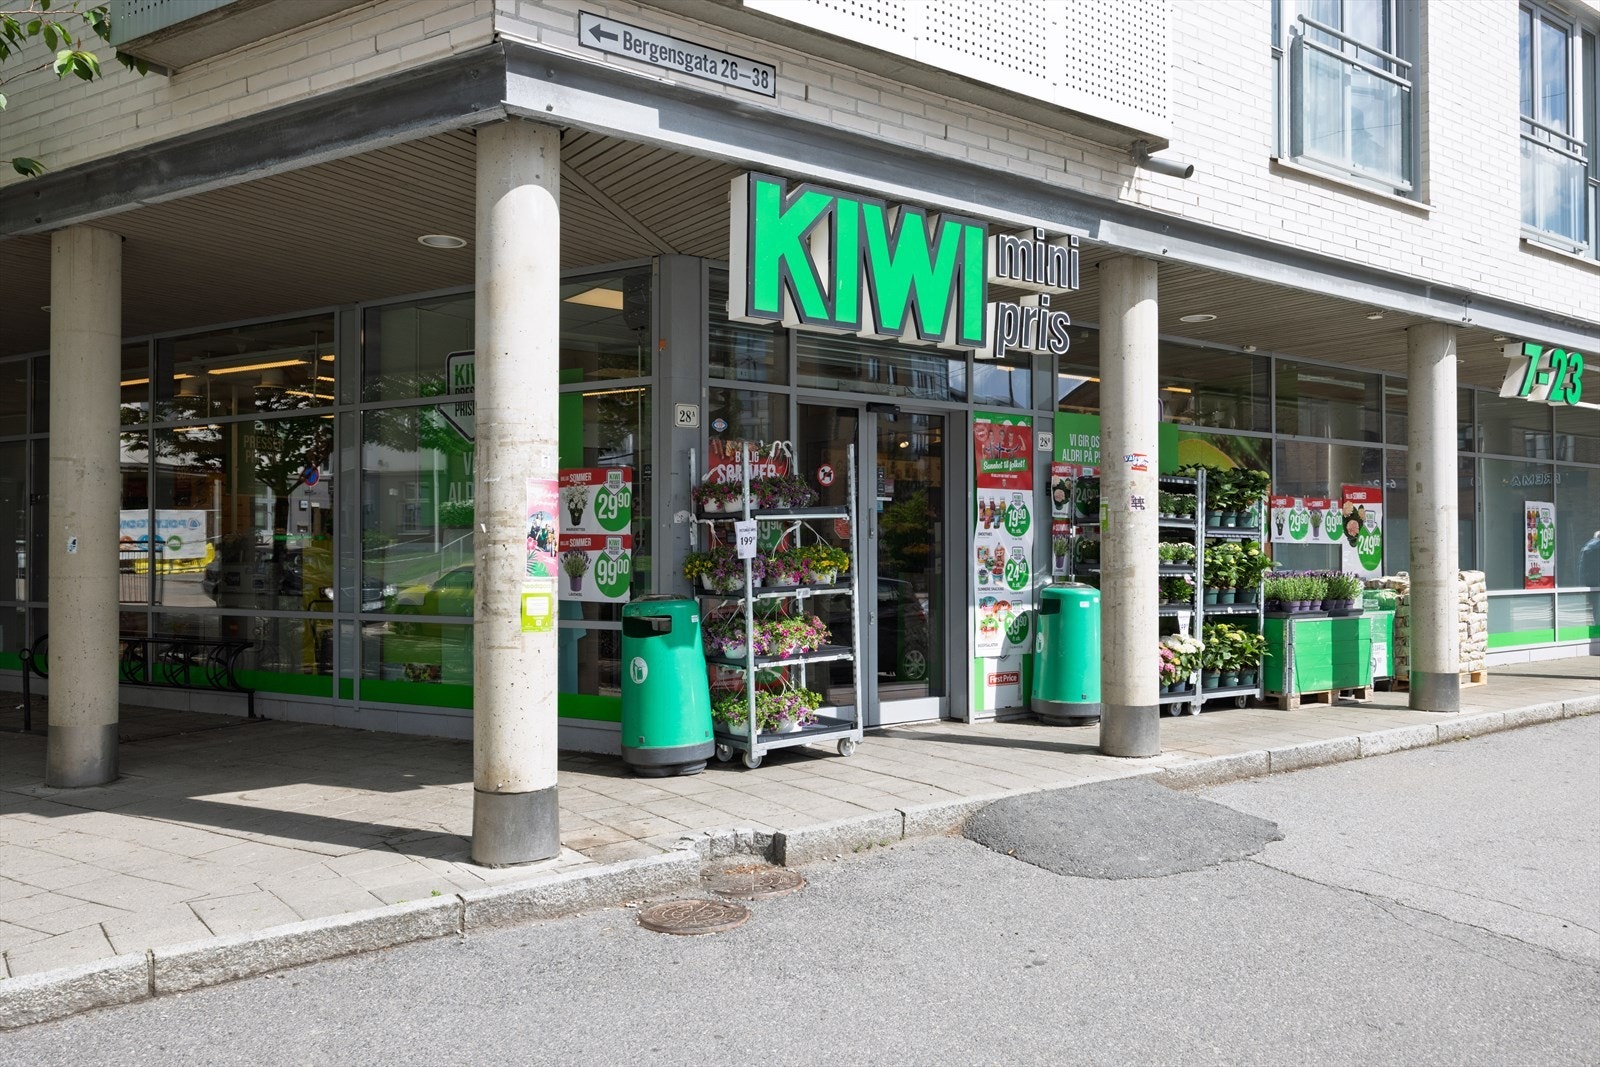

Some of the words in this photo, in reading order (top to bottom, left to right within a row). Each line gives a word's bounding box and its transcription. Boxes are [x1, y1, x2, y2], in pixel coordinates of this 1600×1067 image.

[623, 30, 717, 75] Bergensgata
[748, 171, 988, 348] KIWI
[999, 228, 1079, 290] mini
[997, 294, 1071, 358] pris
[1519, 342, 1584, 405] 7-23
[1062, 449, 1082, 462] ALDRI
[1084, 447, 1093, 463] PÅ
[1070, 433, 1077, 446] VI
[1078, 435, 1090, 447] GIR
[1091, 436, 1100, 448] OS
[569, 473, 592, 482] SOMMER
[569, 538, 592, 547] SOMMER
[990, 675, 1003, 684] First
[1003, 674, 1017, 682] Price
